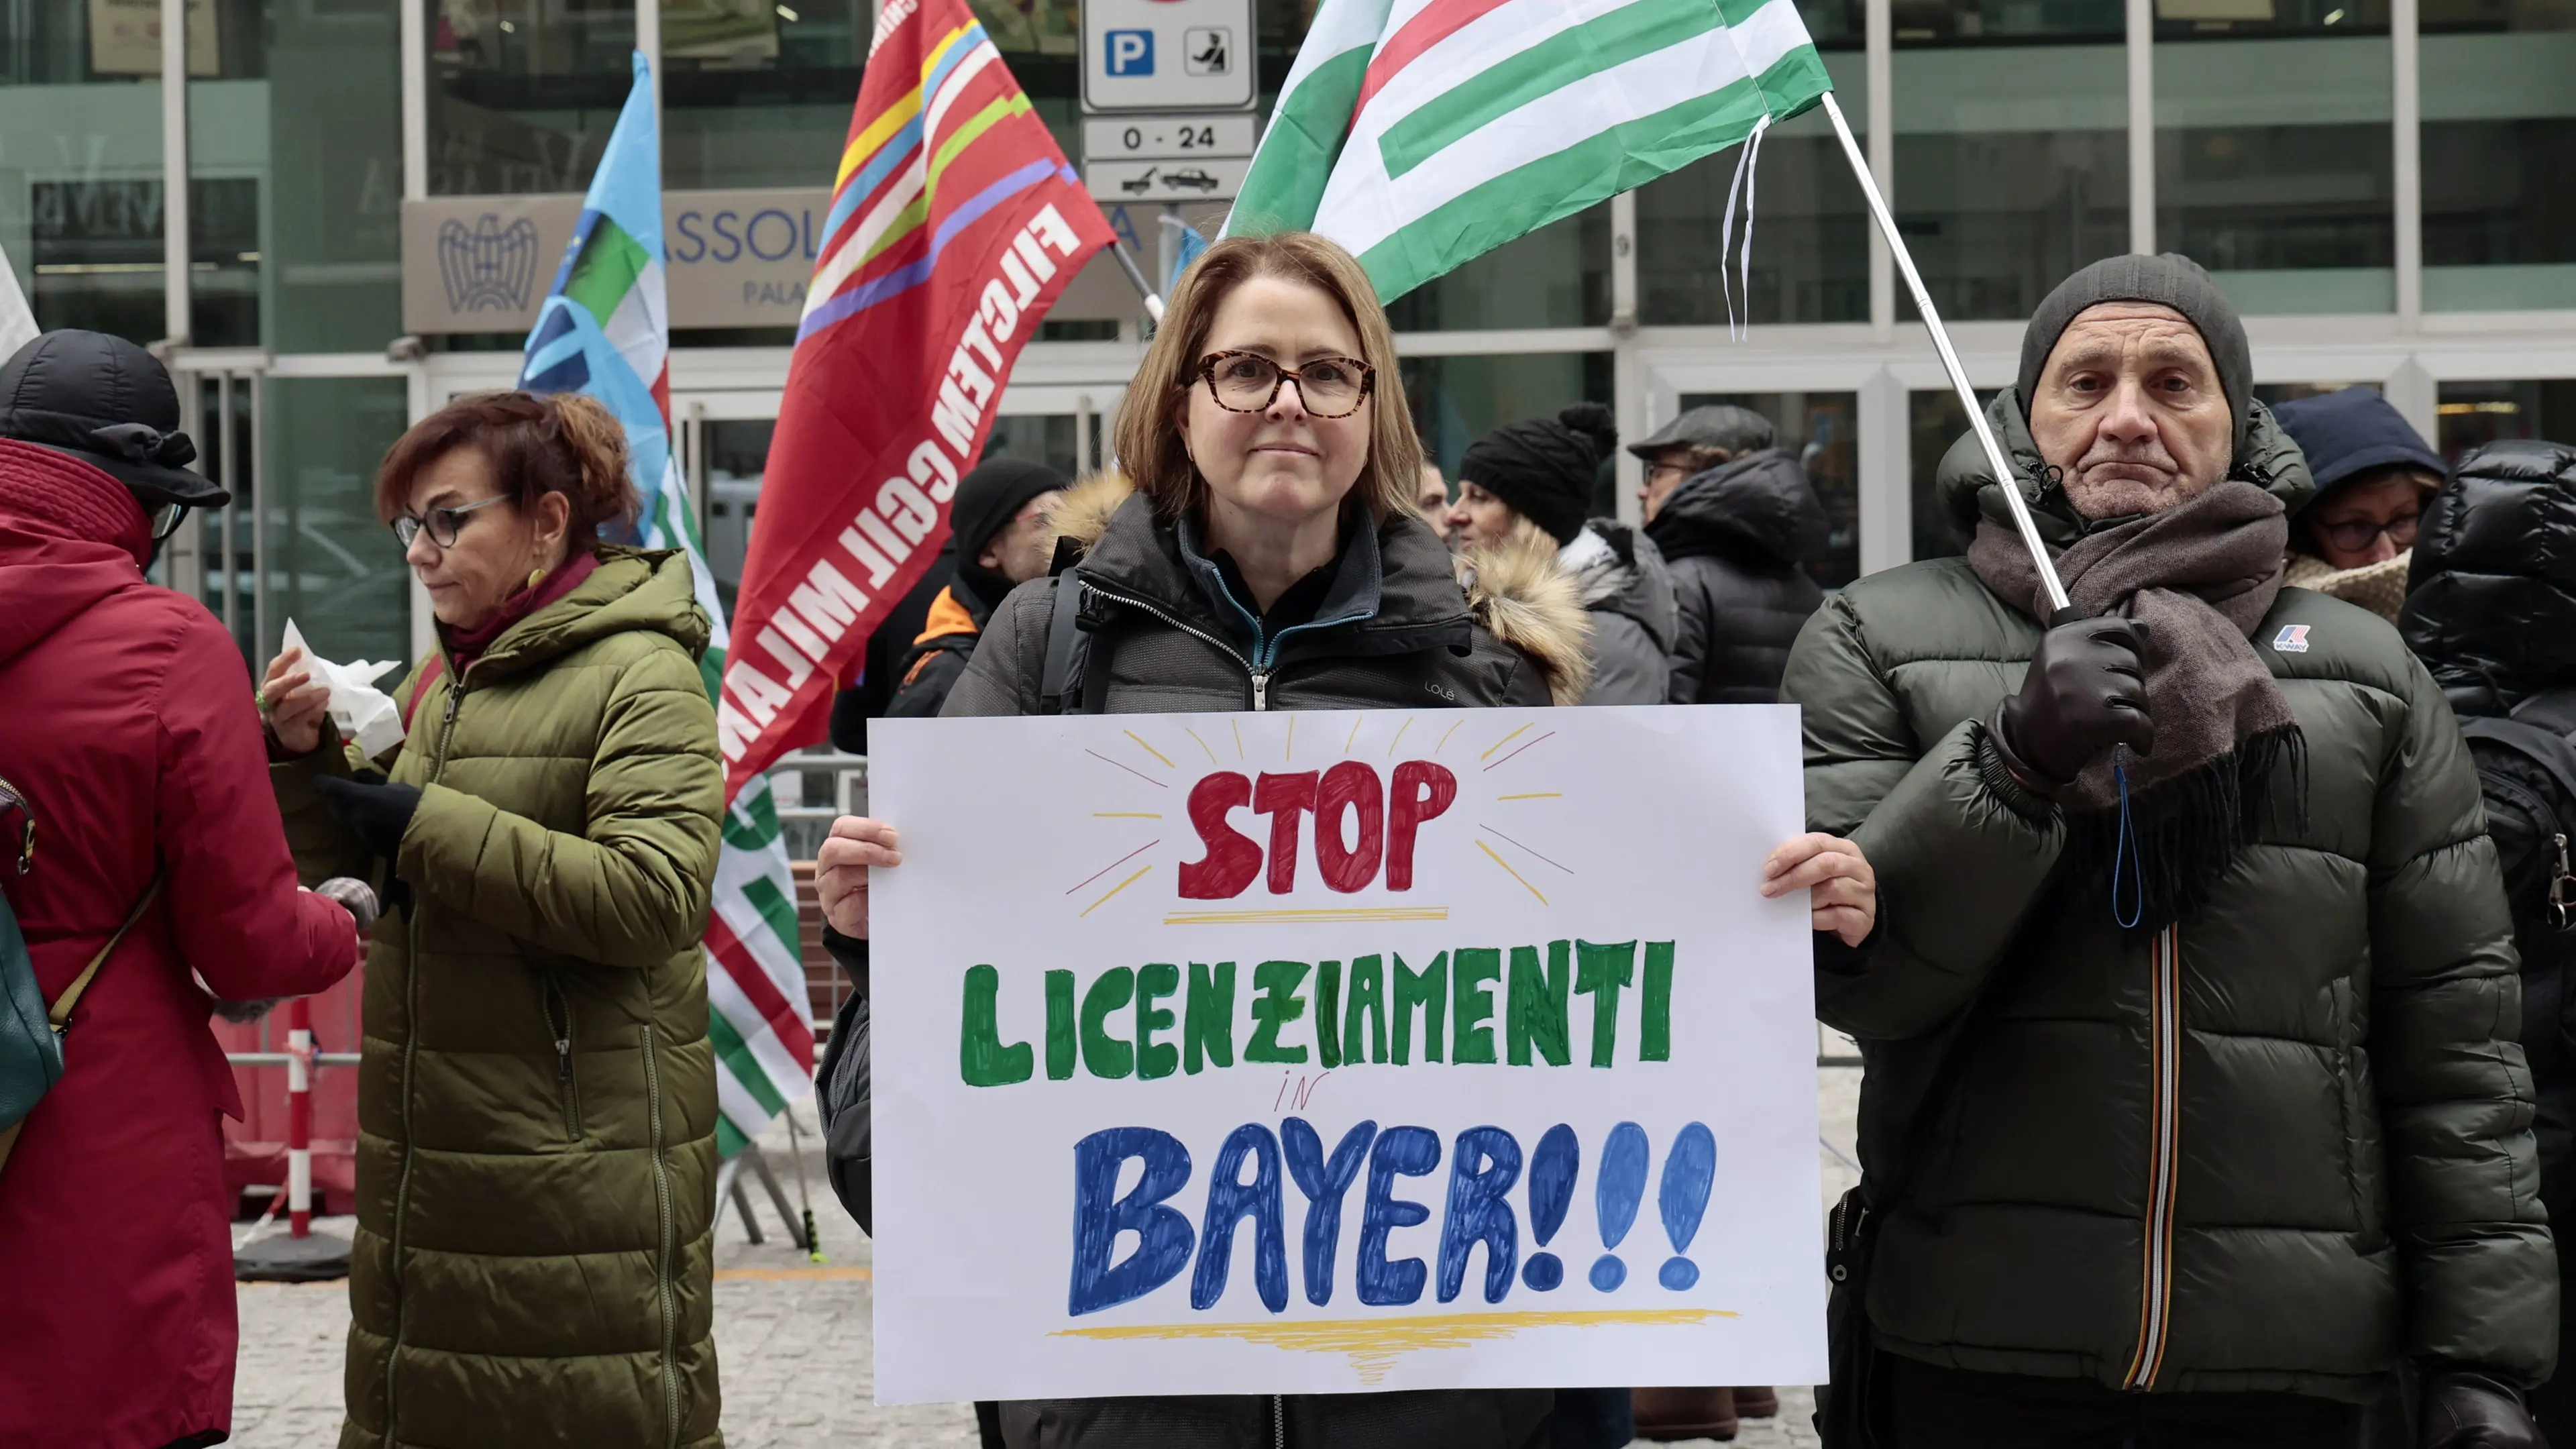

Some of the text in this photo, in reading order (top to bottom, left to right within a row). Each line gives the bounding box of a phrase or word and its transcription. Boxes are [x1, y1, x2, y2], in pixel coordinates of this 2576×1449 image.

[1113, 34, 1146, 74] P
[1123, 127, 1142, 150] 0
[1178, 127, 1216, 149] 24
[663, 209, 818, 262] SSOL
[1178, 761, 1457, 900] STOP
[960, 939, 1676, 1087] LICENZIAMENTI
[1069, 1116, 1717, 1317] BAYER!!!
